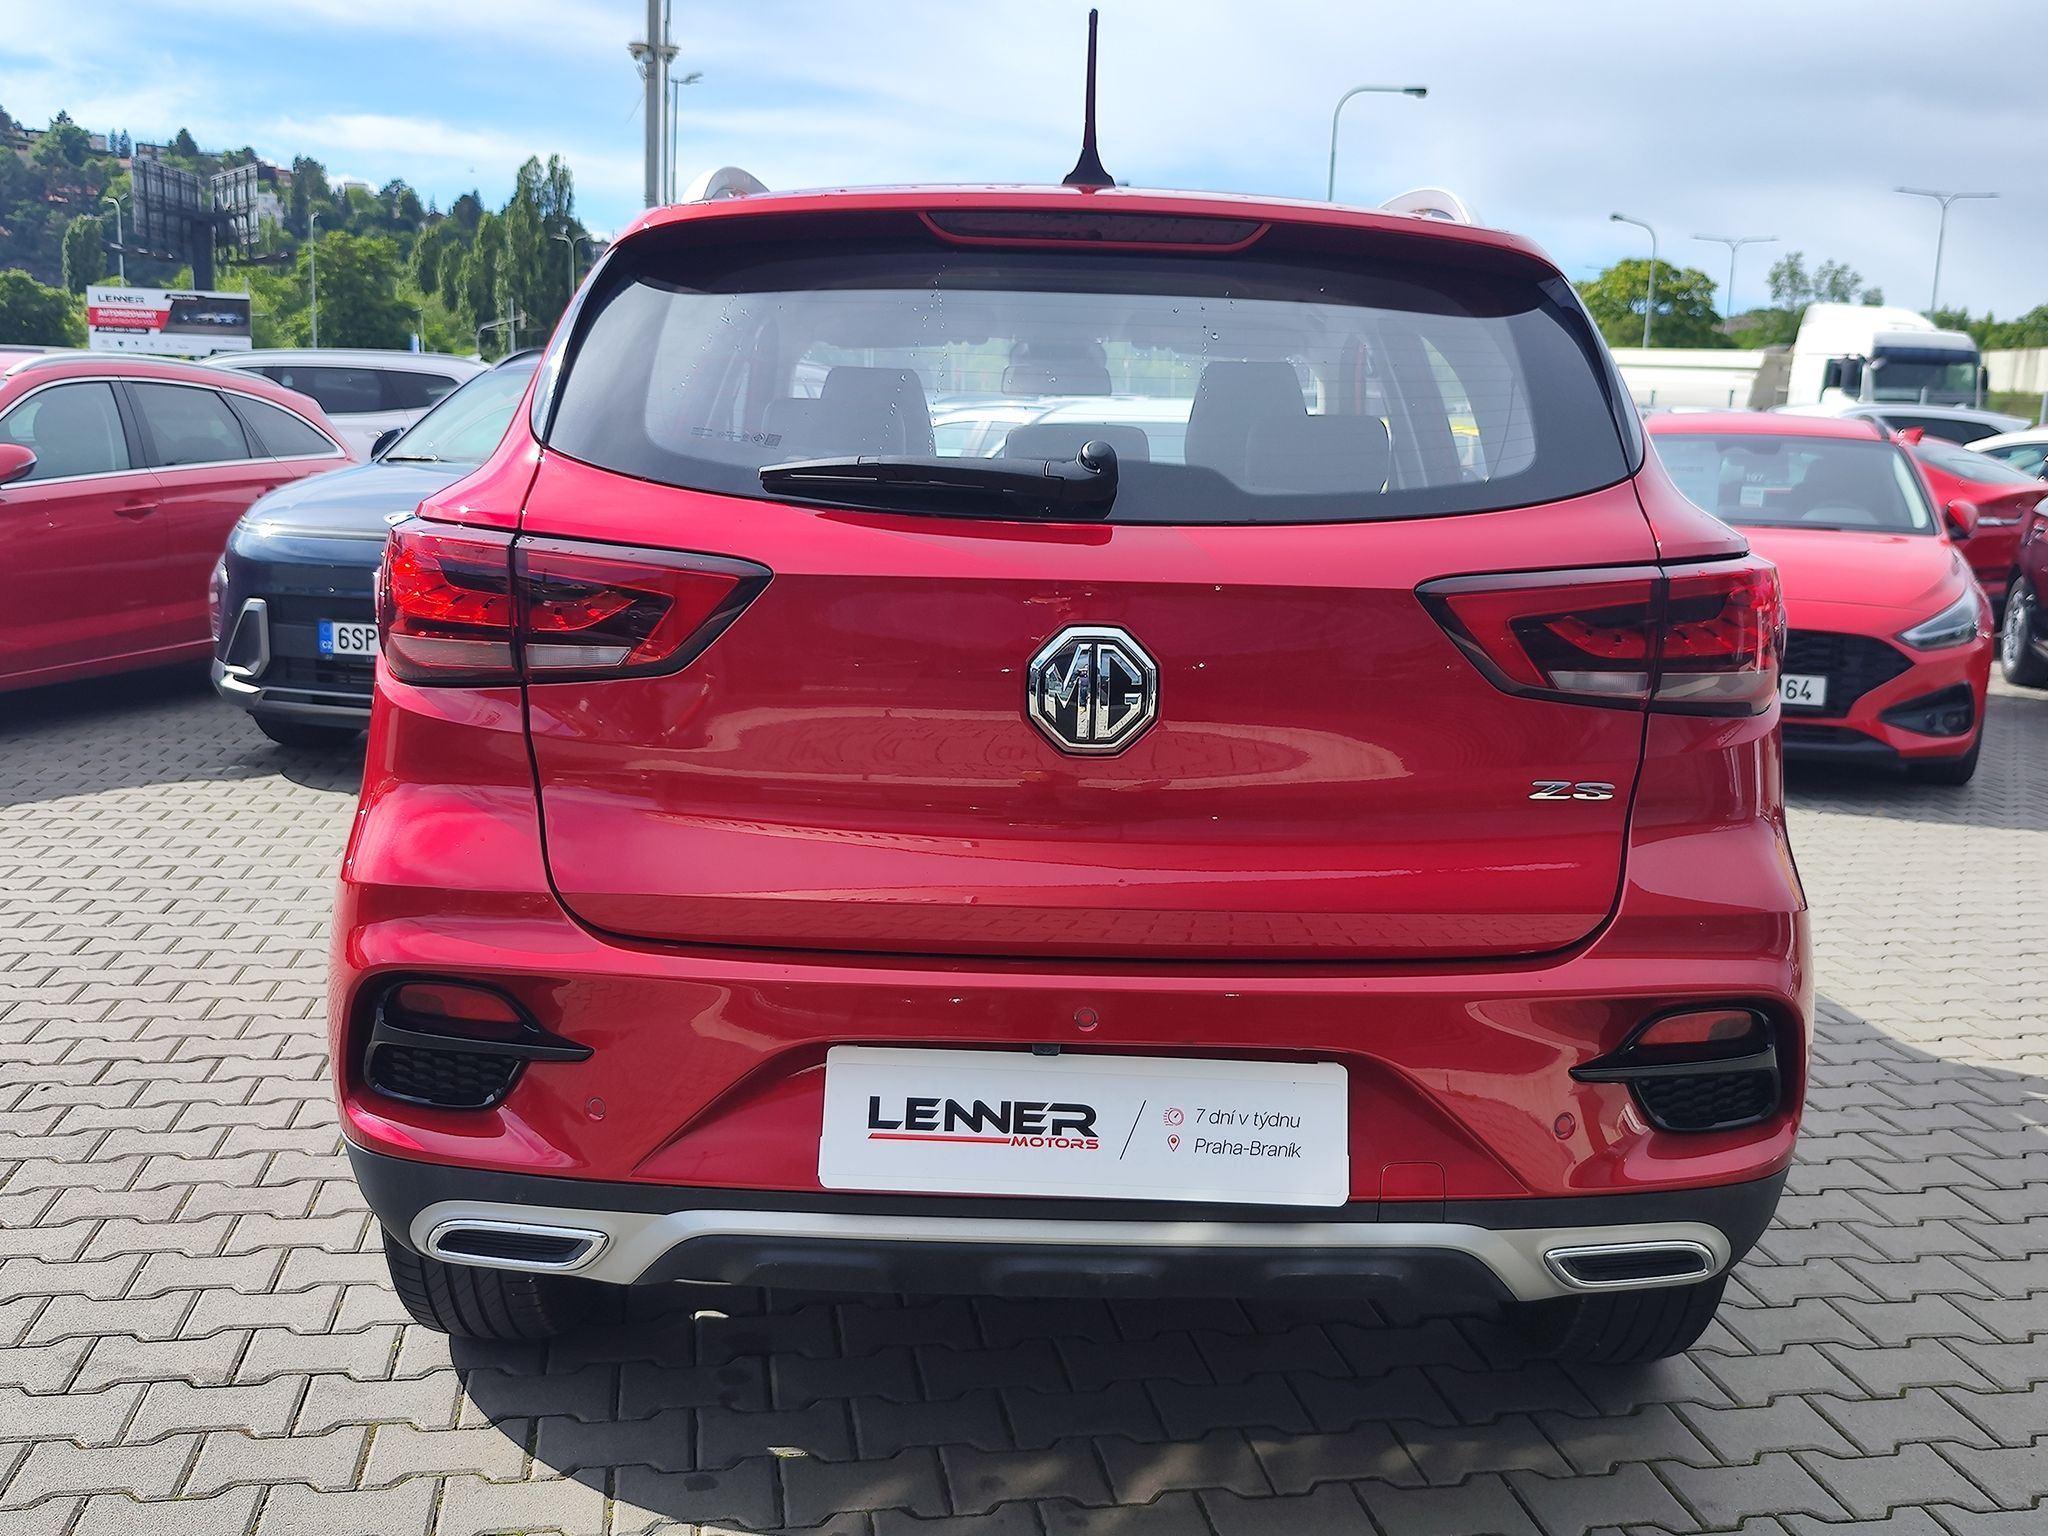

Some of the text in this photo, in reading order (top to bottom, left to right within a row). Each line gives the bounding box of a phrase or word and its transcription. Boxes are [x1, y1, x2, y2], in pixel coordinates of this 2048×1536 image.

[1044, 643, 1143, 740] MG
[1528, 780, 1616, 801] ZS
[867, 1095, 1100, 1138] LENNER
[1195, 1108, 1301, 1130] 7 dní v týdnu
[1010, 1136, 1100, 1150] MOTORS
[1193, 1137, 1302, 1159] Praha-Braník
